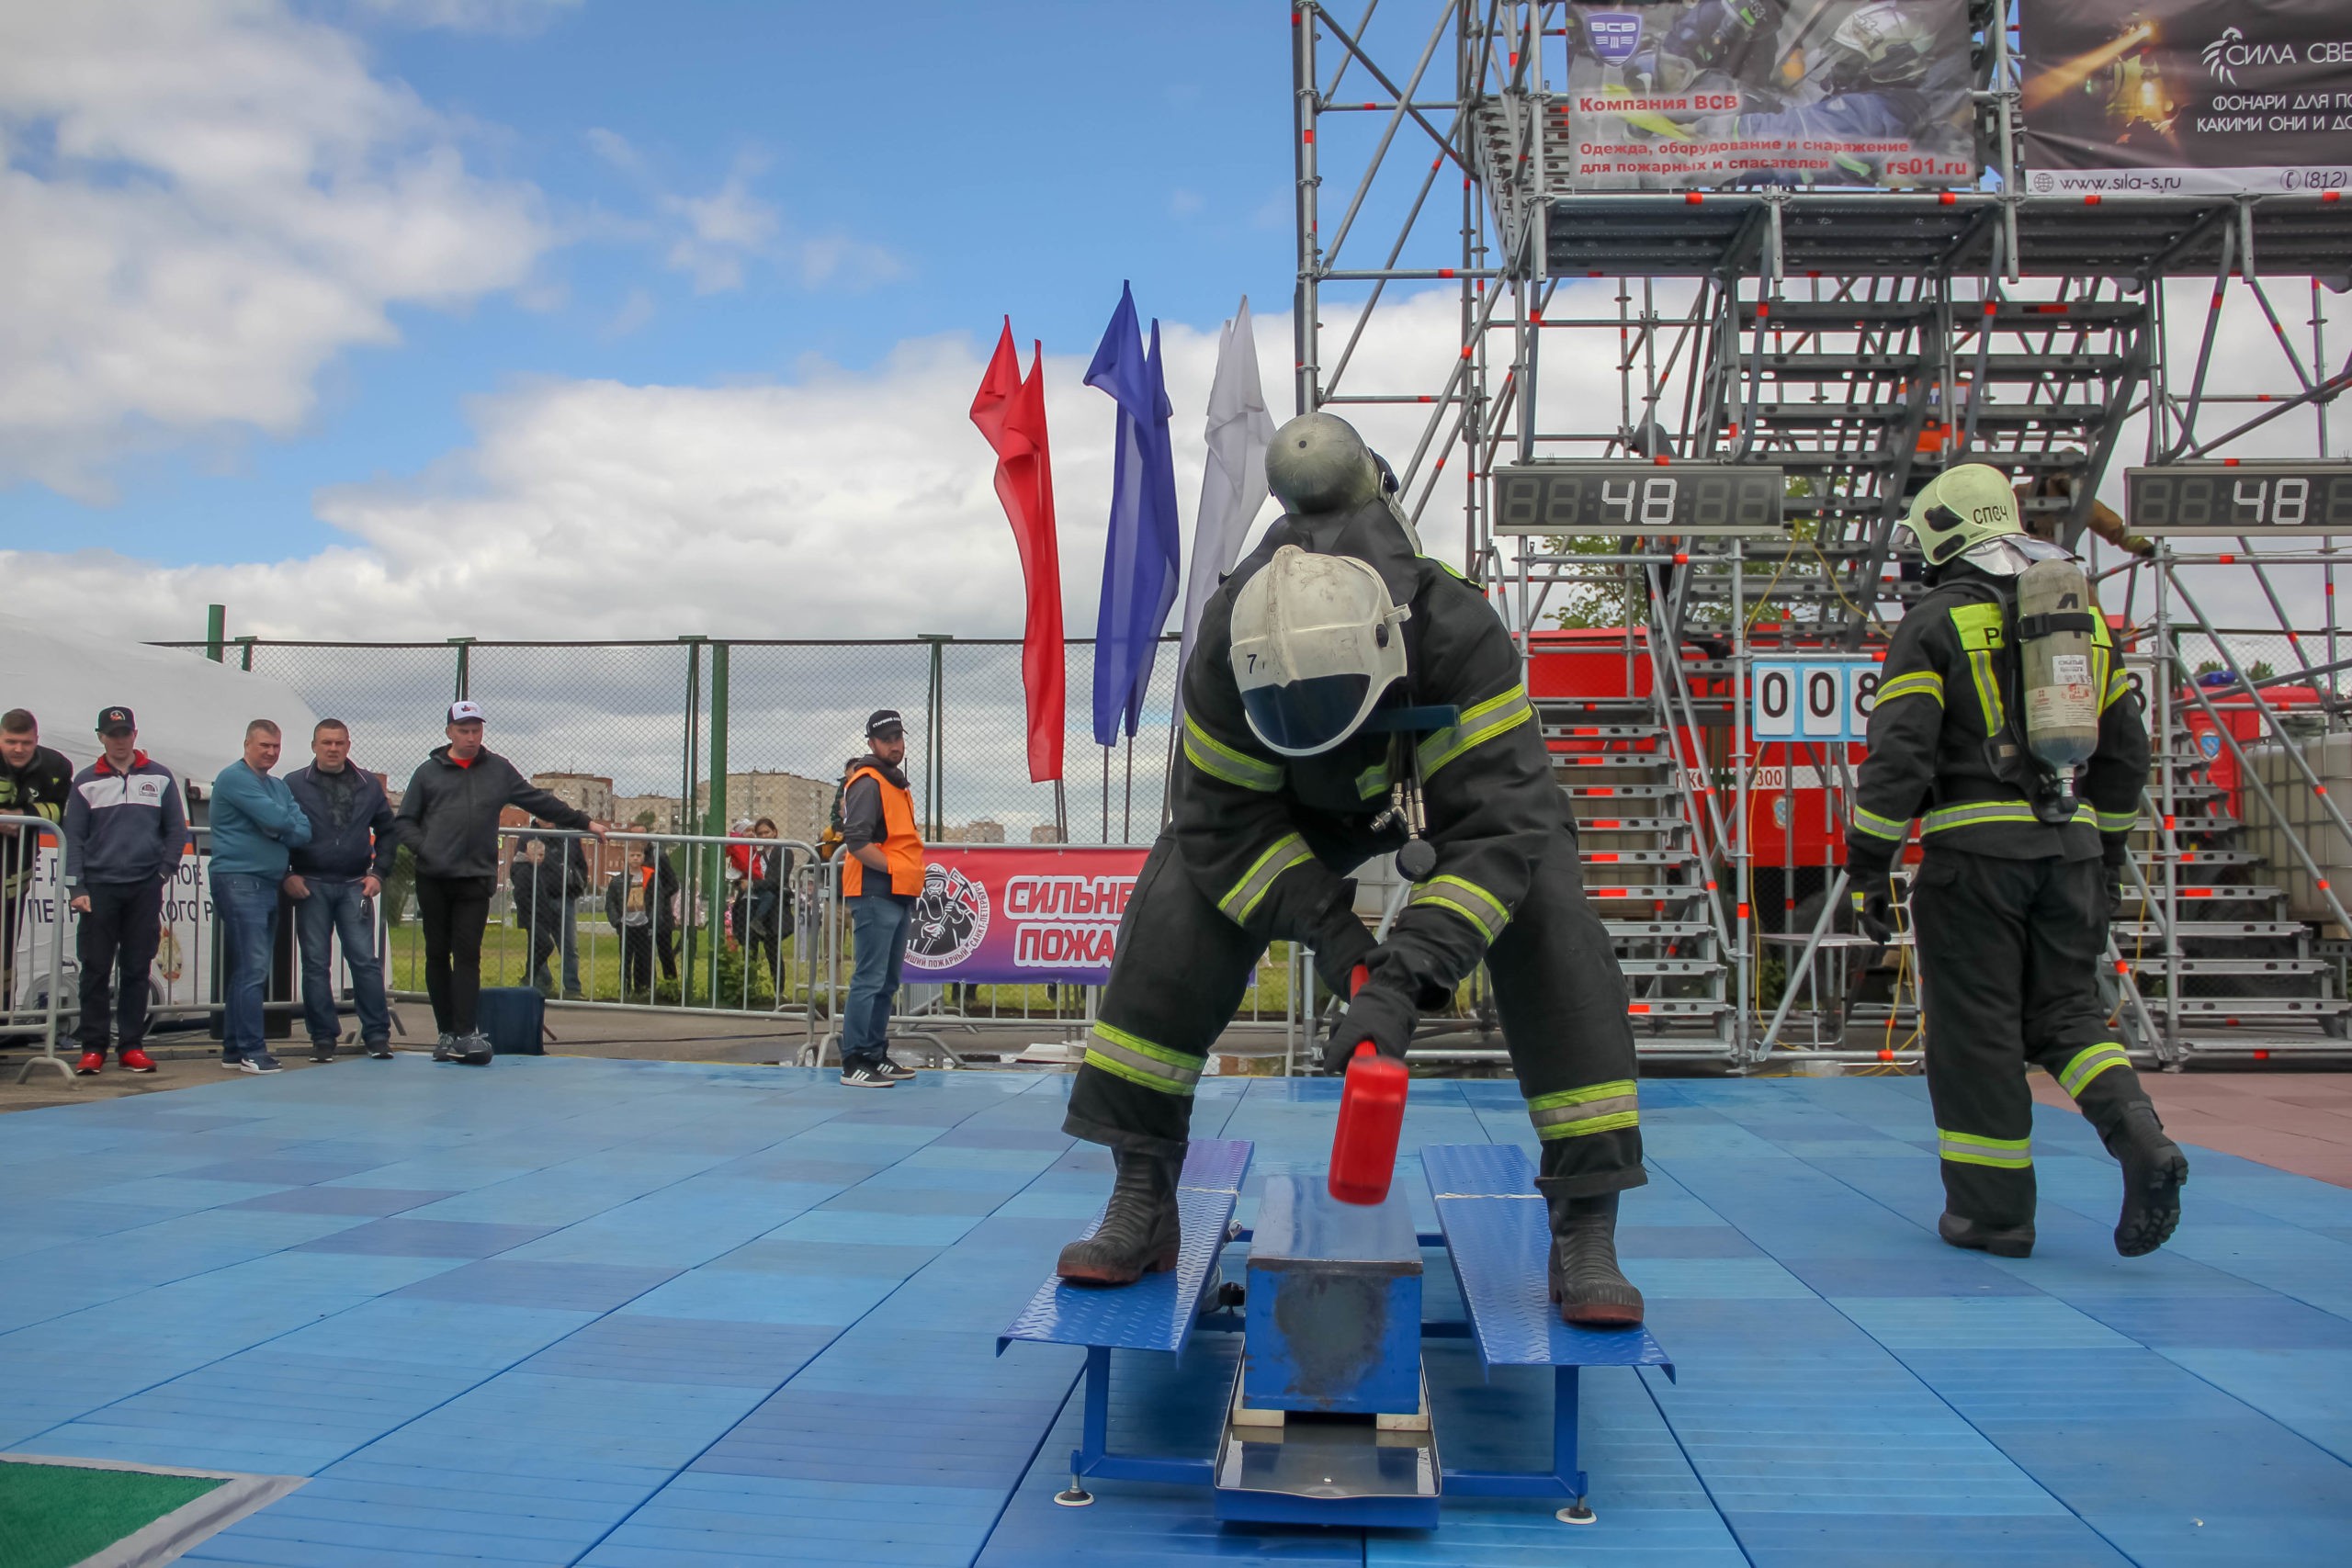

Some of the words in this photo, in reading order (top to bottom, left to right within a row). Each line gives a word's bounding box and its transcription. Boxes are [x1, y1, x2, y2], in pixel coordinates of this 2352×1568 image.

[1591, 22, 1636, 32] ВСВ
[2226, 44, 2297, 65] СИЛА
[1579, 96, 1687, 112] Компания
[1694, 96, 1737, 109] ВСВ
[2212, 96, 2286, 110] ФОНАРИ
[2292, 94, 2329, 109] ДЛЯ
[2197, 117, 2262, 132] КАКИМИ
[2268, 116, 2306, 131] ОНИ
[2312, 116, 2324, 130] И
[1580, 142, 1653, 157] Одежда,
[1658, 140, 1781, 157] оборудование
[1787, 141, 1796, 150] и
[1803, 141, 1910, 154] снаряжение
[1580, 162, 1611, 175] для
[1616, 162, 1706, 175] пожарных
[1713, 160, 1723, 169] и
[1729, 157, 1829, 169] спасателей
[1886, 158, 1967, 175] rs01.ru
[2060, 173, 2181, 190] www.sila-s.ru
[2304, 172, 2347, 189] (812)
[1601, 478, 1678, 525] 48
[2233, 478, 2310, 525] 48
[1973, 505, 2009, 525] СПСЧ
[1247, 653, 1258, 674] 7
[1762, 671, 1882, 718] 008
[1019, 929, 1114, 961] ПОЖА
[928, 949, 969, 967] ПОЖАРНЫЙ
